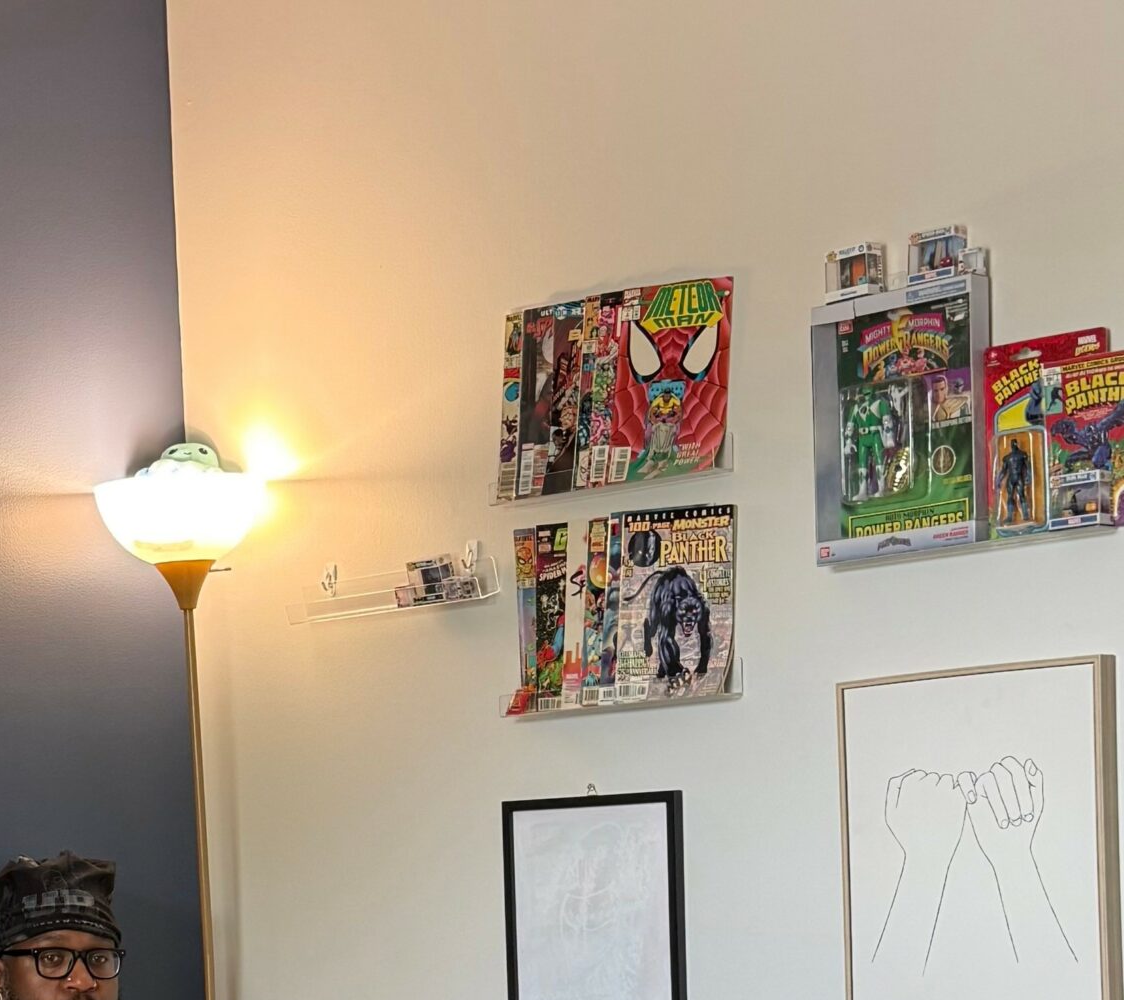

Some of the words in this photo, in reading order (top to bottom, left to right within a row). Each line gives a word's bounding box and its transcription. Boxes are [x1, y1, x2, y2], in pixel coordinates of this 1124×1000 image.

[644, 282, 722, 321] METEOR
[653, 312, 715, 328] MAN
[907, 317, 940, 328] MORPHIN
[864, 324, 891, 343] MIGHTY
[862, 338, 899, 378] POWER
[903, 331, 950, 361] RANGERS
[991, 358, 1041, 394] BLACK
[627, 512, 675, 523] MARVEL
[685, 507, 731, 518] COMICS
[672, 515, 730, 532] MONSTER
[671, 530, 716, 542] BLACK
[659, 536, 730, 567] PANTHER
[699, 565, 708, 592] 4
